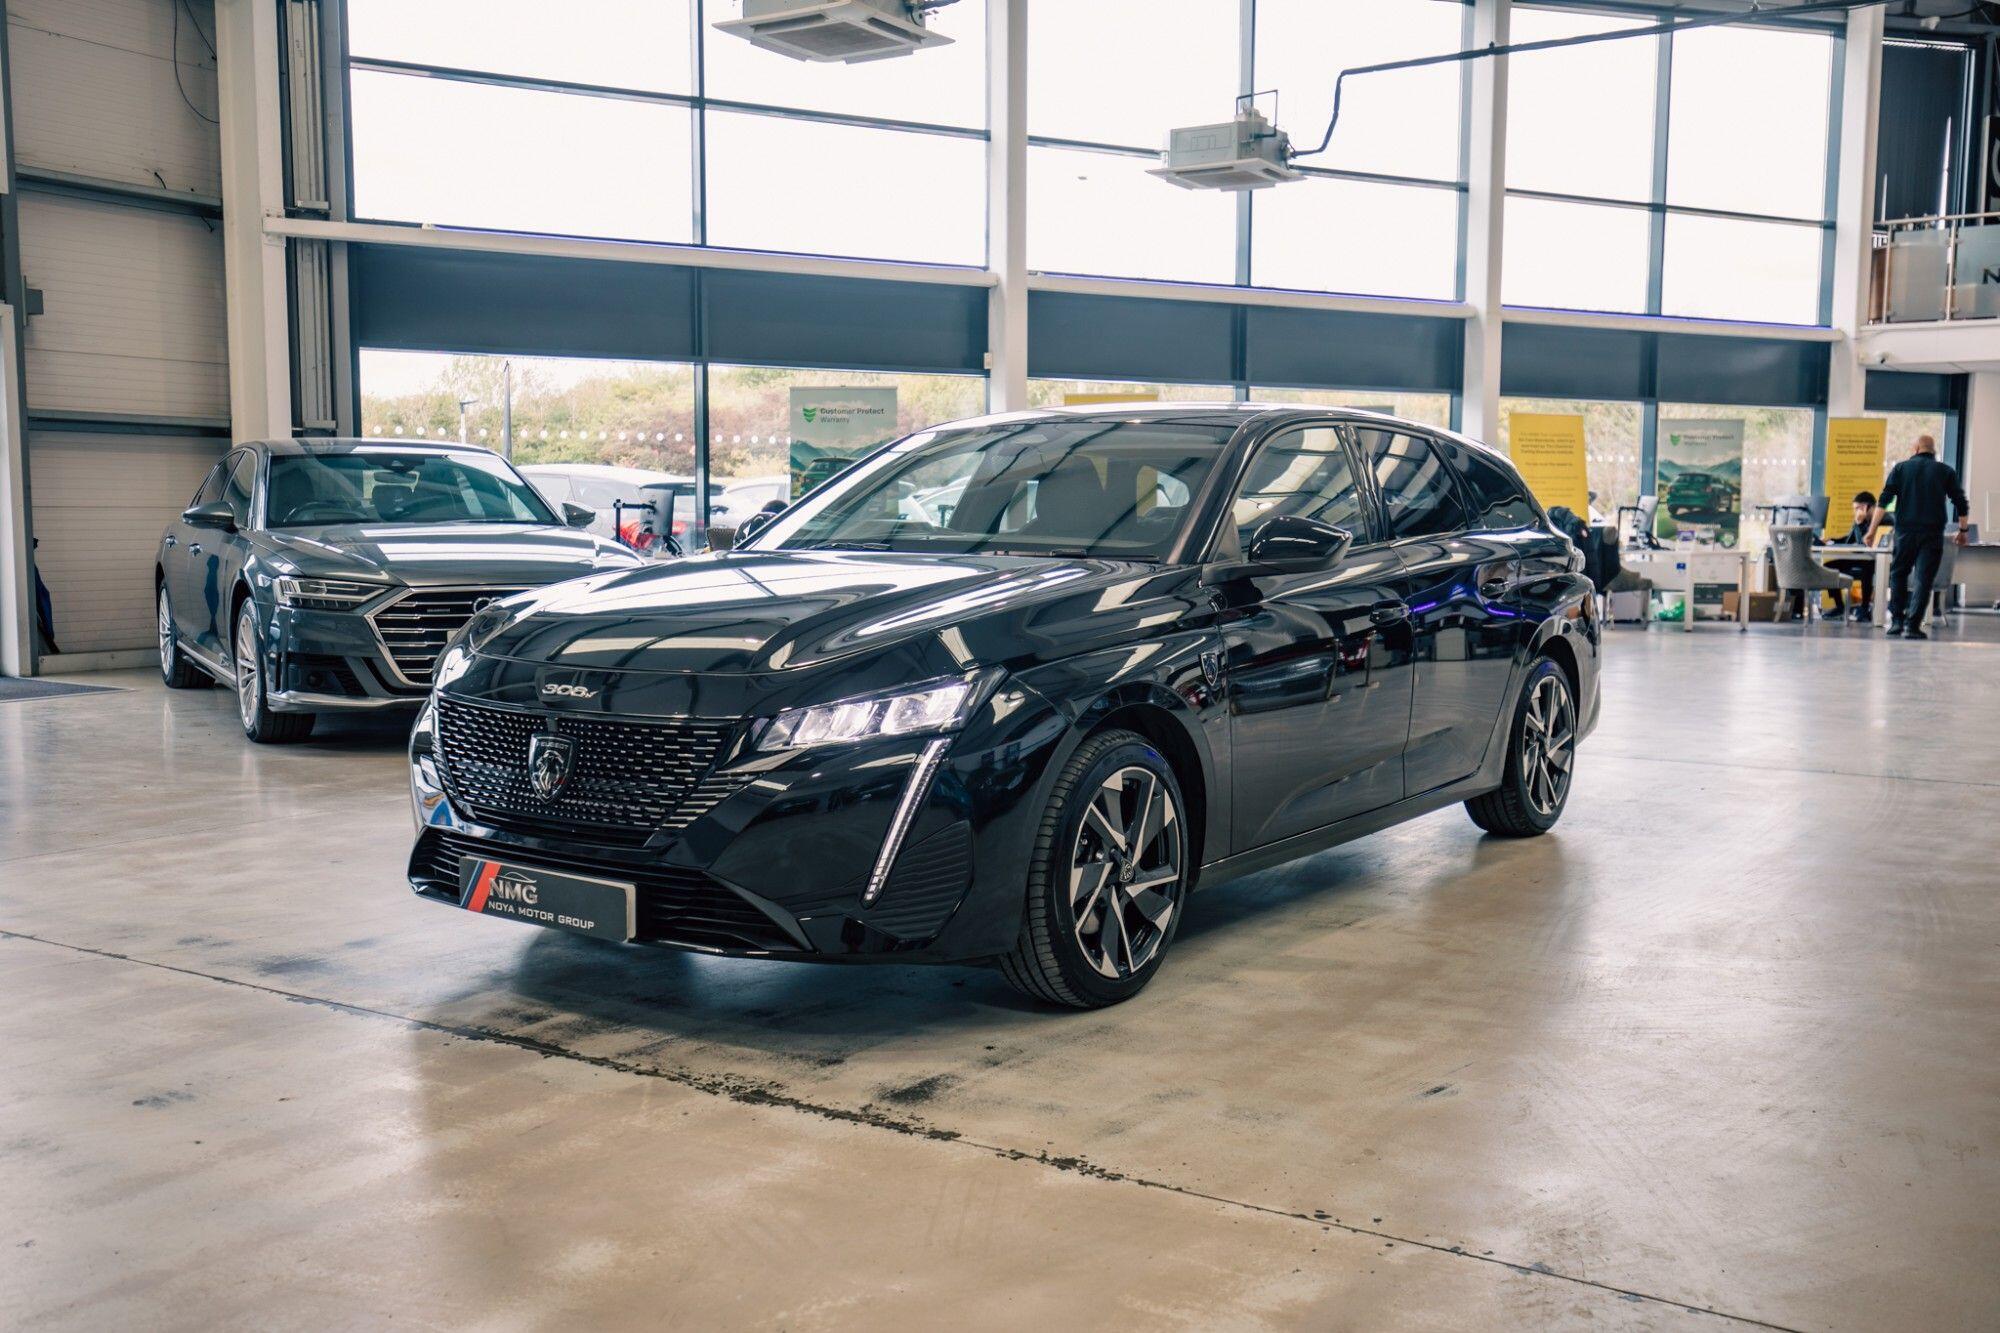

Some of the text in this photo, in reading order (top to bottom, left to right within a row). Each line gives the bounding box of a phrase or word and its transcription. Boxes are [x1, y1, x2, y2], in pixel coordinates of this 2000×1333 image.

[820, 407, 885, 415] Customer Protect
[488, 877, 538, 905] NMG
[488, 900, 595, 930] NOYA MOTOR GROUP
